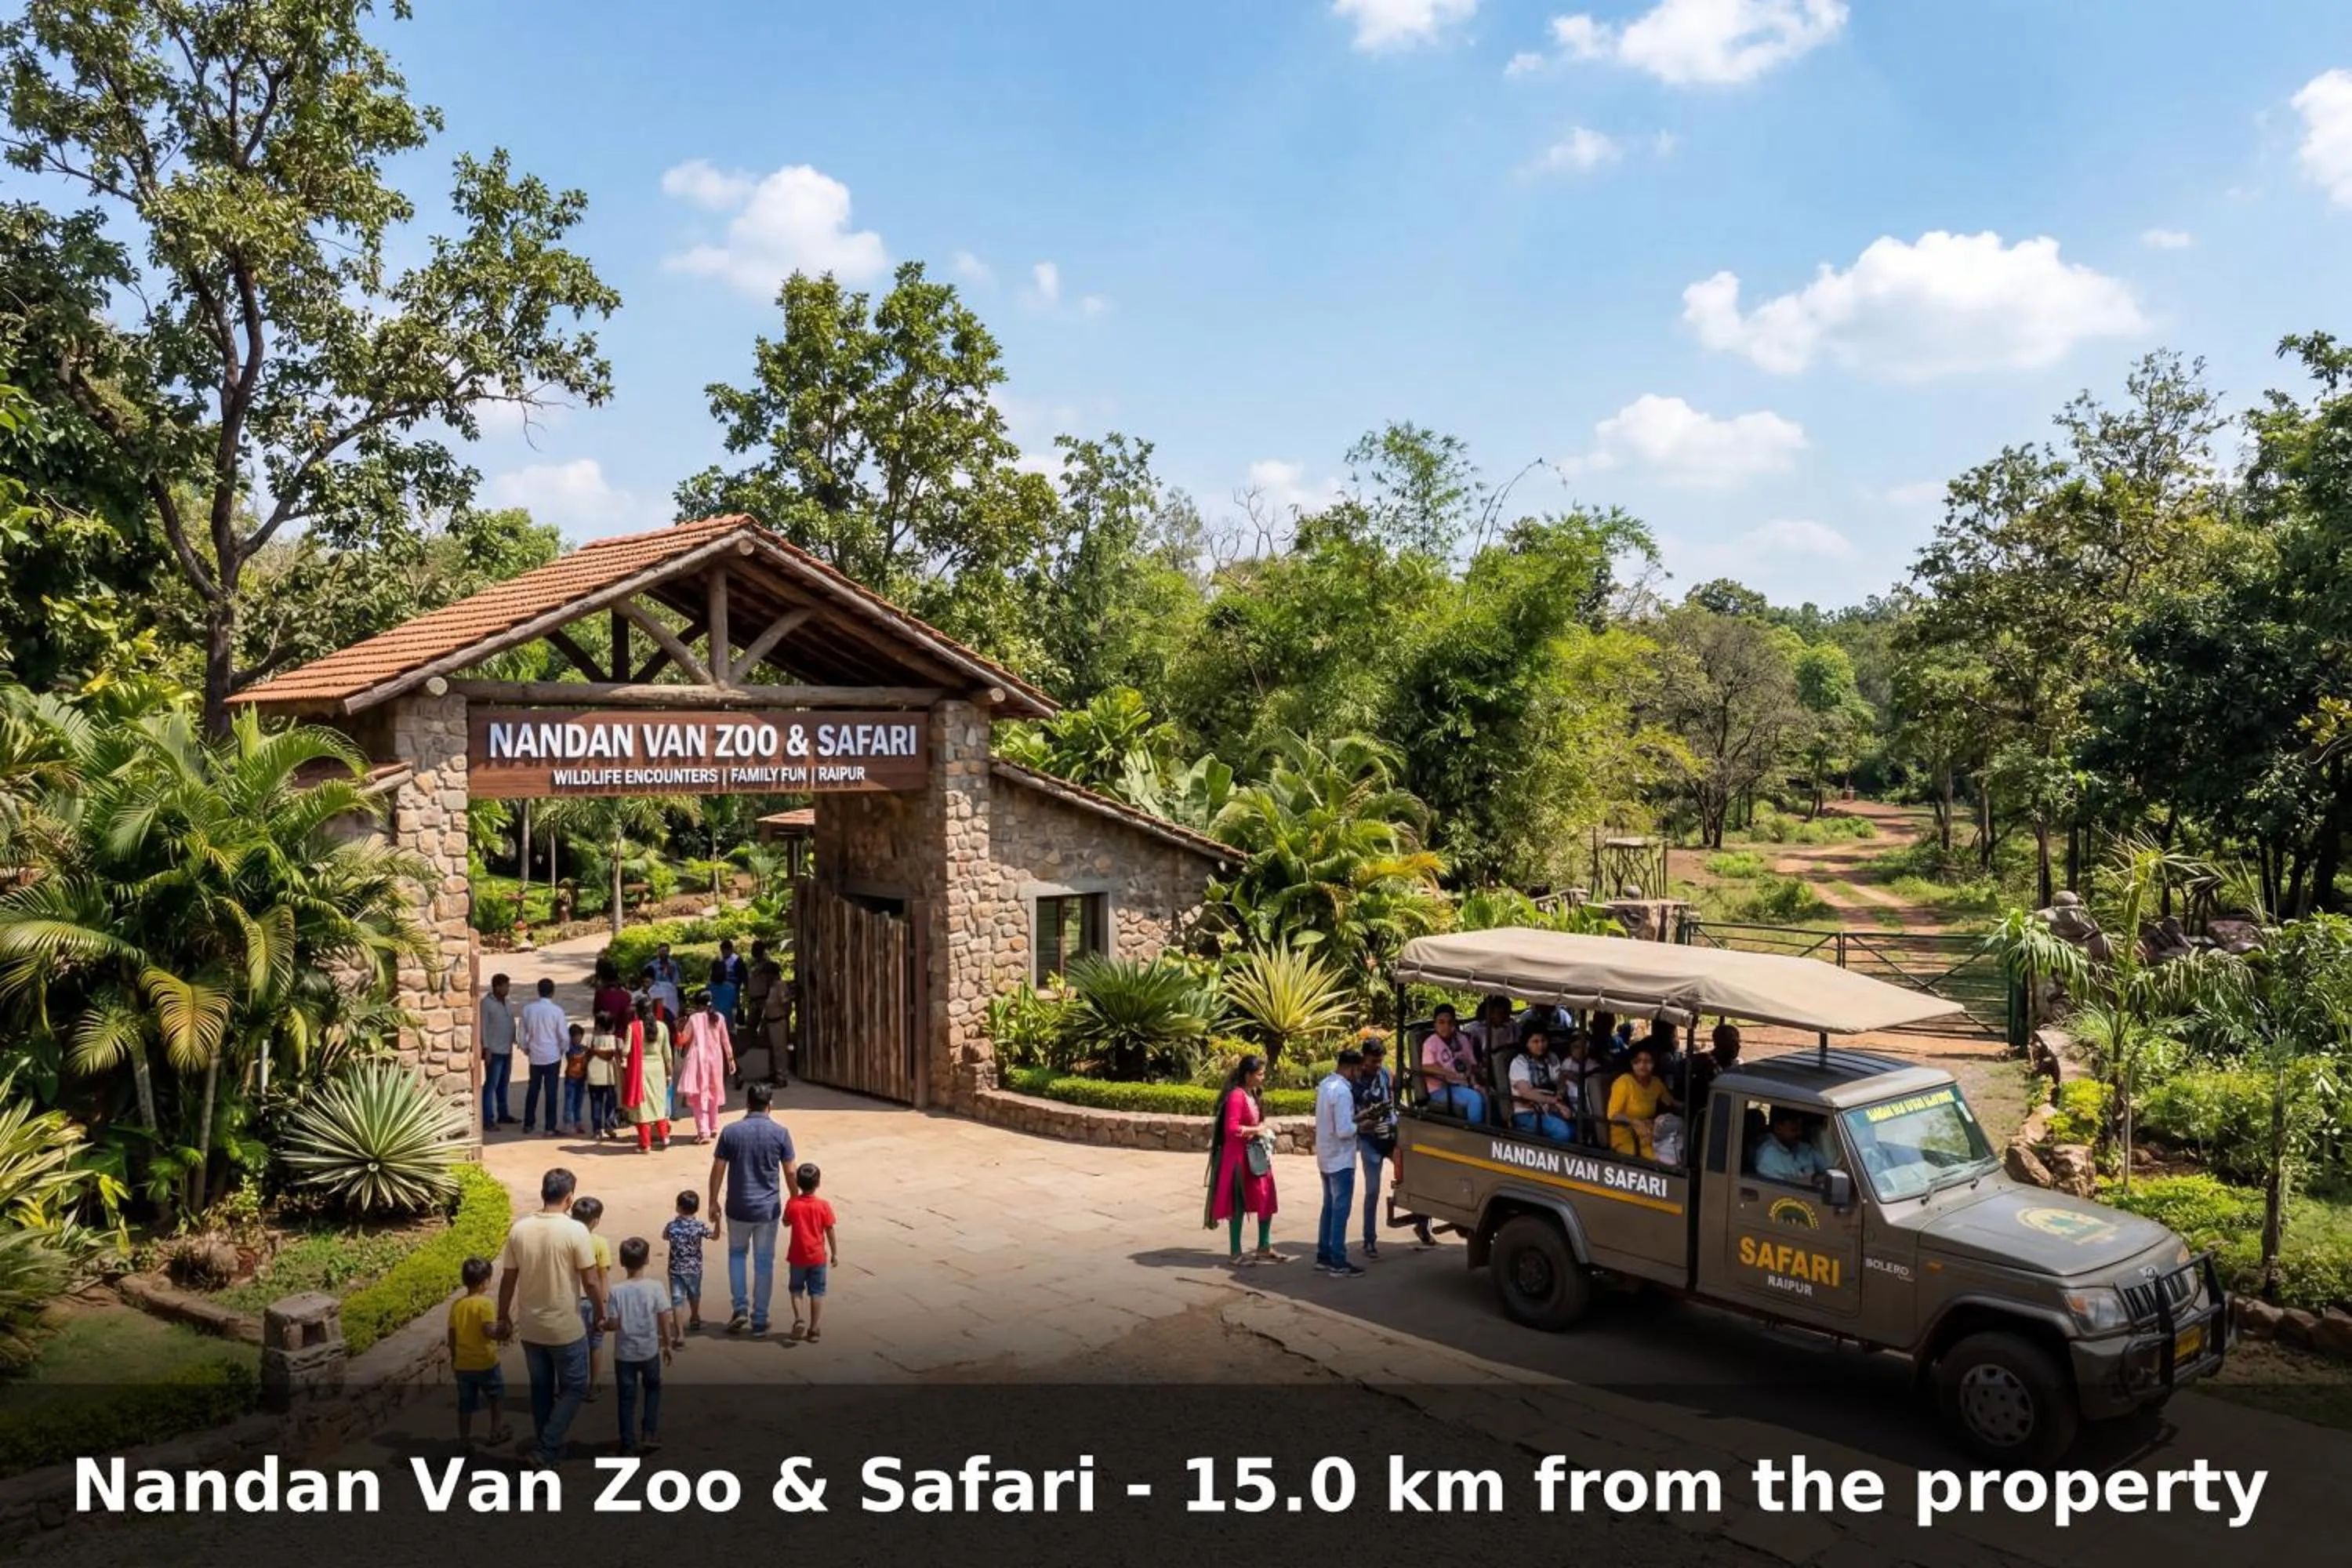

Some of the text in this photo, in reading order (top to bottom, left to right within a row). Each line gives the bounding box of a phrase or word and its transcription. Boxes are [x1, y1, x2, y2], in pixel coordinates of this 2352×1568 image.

[489, 723, 916, 758] NANDAN VAN ZOO & SAFARI
[554, 768, 621, 785] WILDLIFE
[625, 768, 717, 784] ENCOUNTERS
[731, 767, 777, 783] FAMILY
[781, 766, 807, 782] FUN
[818, 765, 865, 782] RAIPUR
[1492, 1141, 1668, 1198] NANDAN VAN SAFARI
[1739, 1236, 1840, 1287] SAFARI
[1865, 1258, 1909, 1276] BOLERO
[1767, 1274, 1813, 1296] RAIPUR
